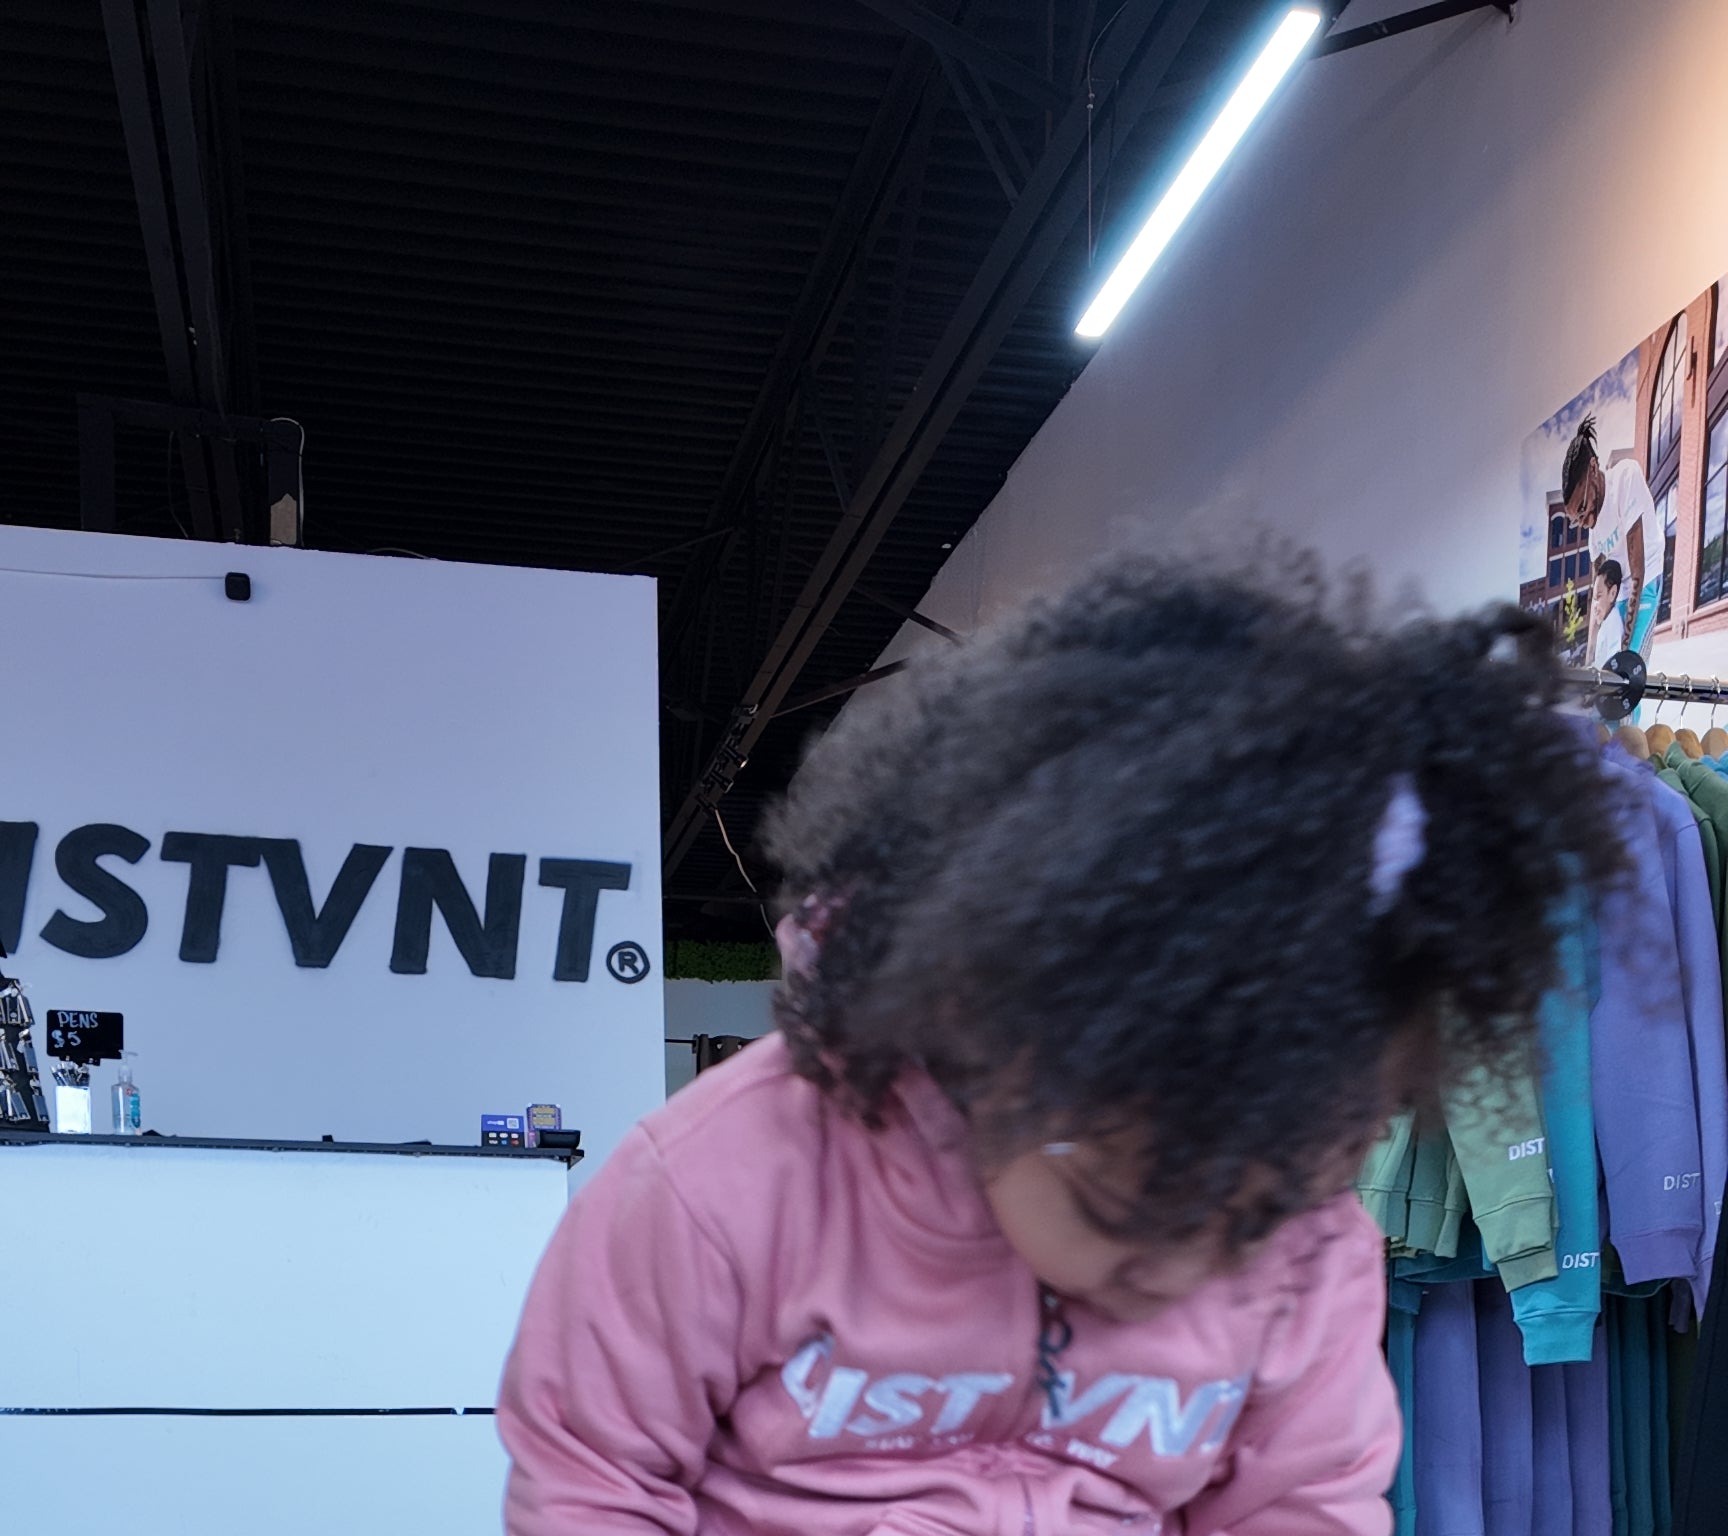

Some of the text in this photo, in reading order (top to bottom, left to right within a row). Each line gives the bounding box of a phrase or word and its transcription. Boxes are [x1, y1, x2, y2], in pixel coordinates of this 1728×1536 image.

[57, 1011, 99, 1028] PENS
[1508, 1137, 1545, 1161] DIST
[1663, 1172, 1701, 1191] DIST
[1561, 1251, 1600, 1269] DIST
